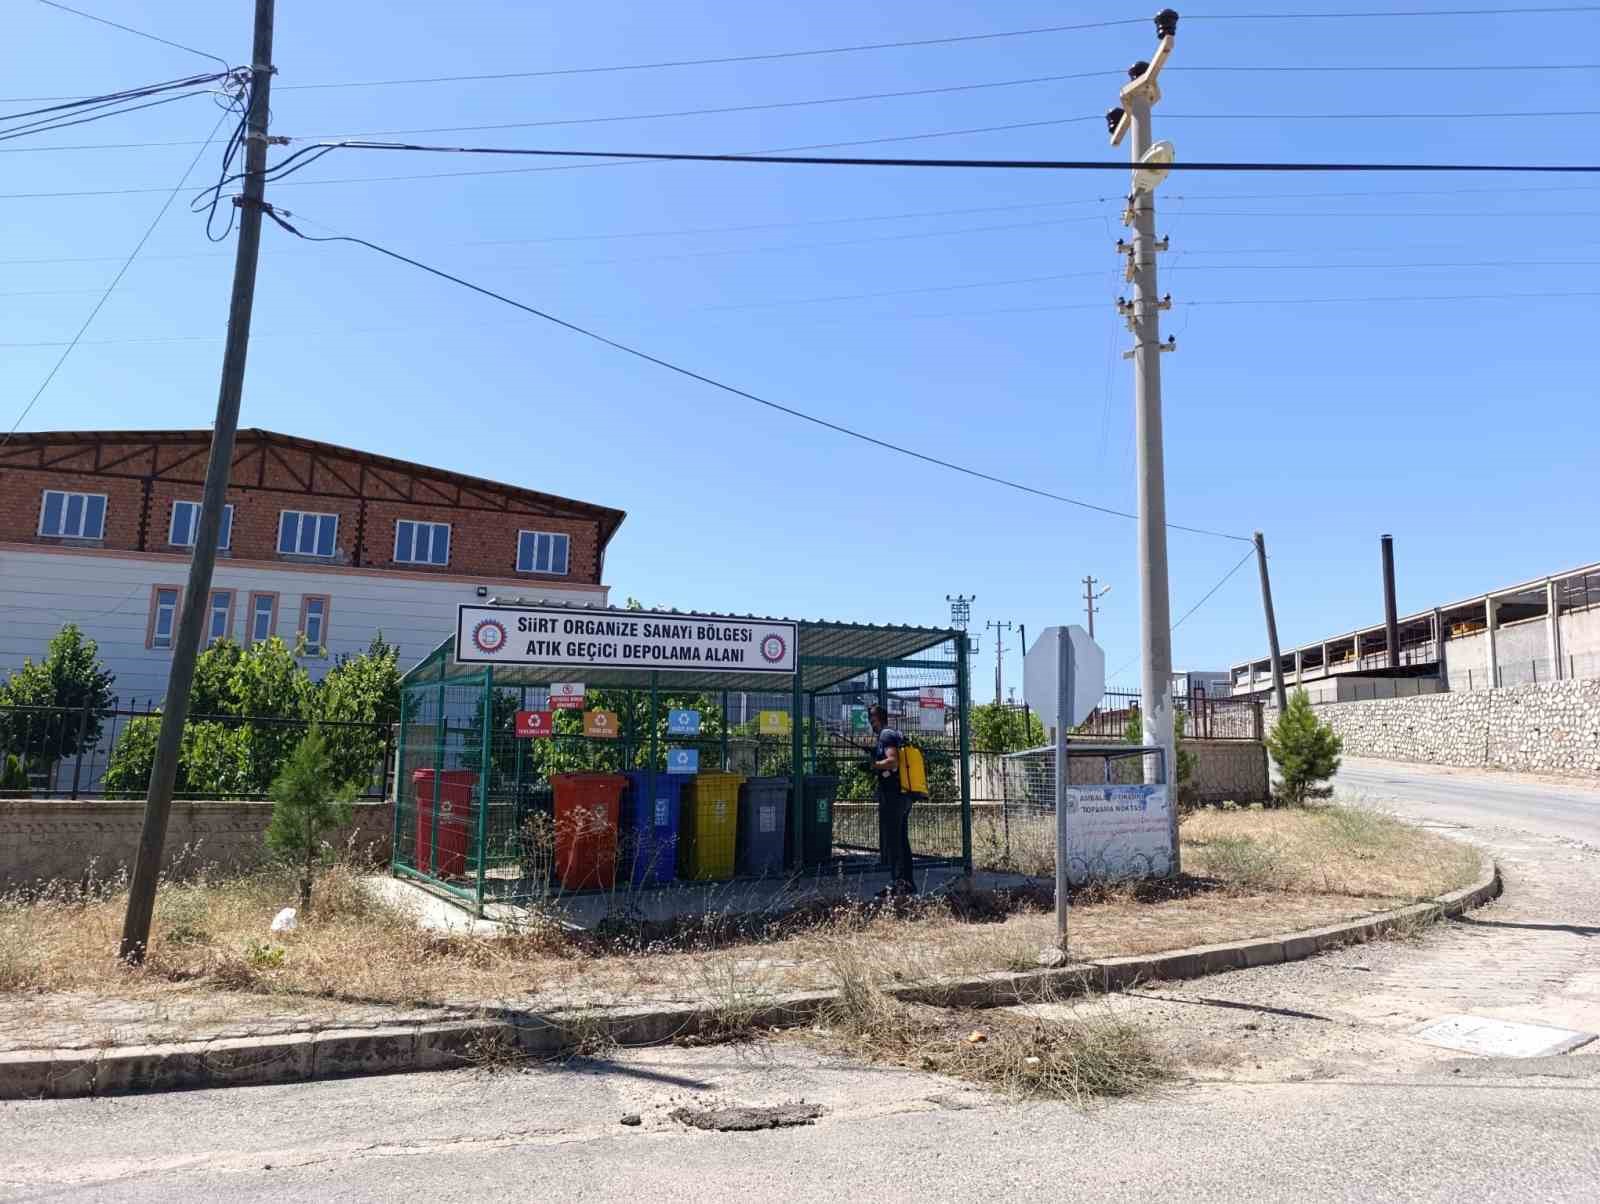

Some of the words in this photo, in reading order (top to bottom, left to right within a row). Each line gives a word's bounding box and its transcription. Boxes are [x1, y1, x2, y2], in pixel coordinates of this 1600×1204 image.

[526, 640, 562, 656] ATIK
[622, 644, 701, 661] DEPOLAMA
[705, 647, 744, 662] ALANI
